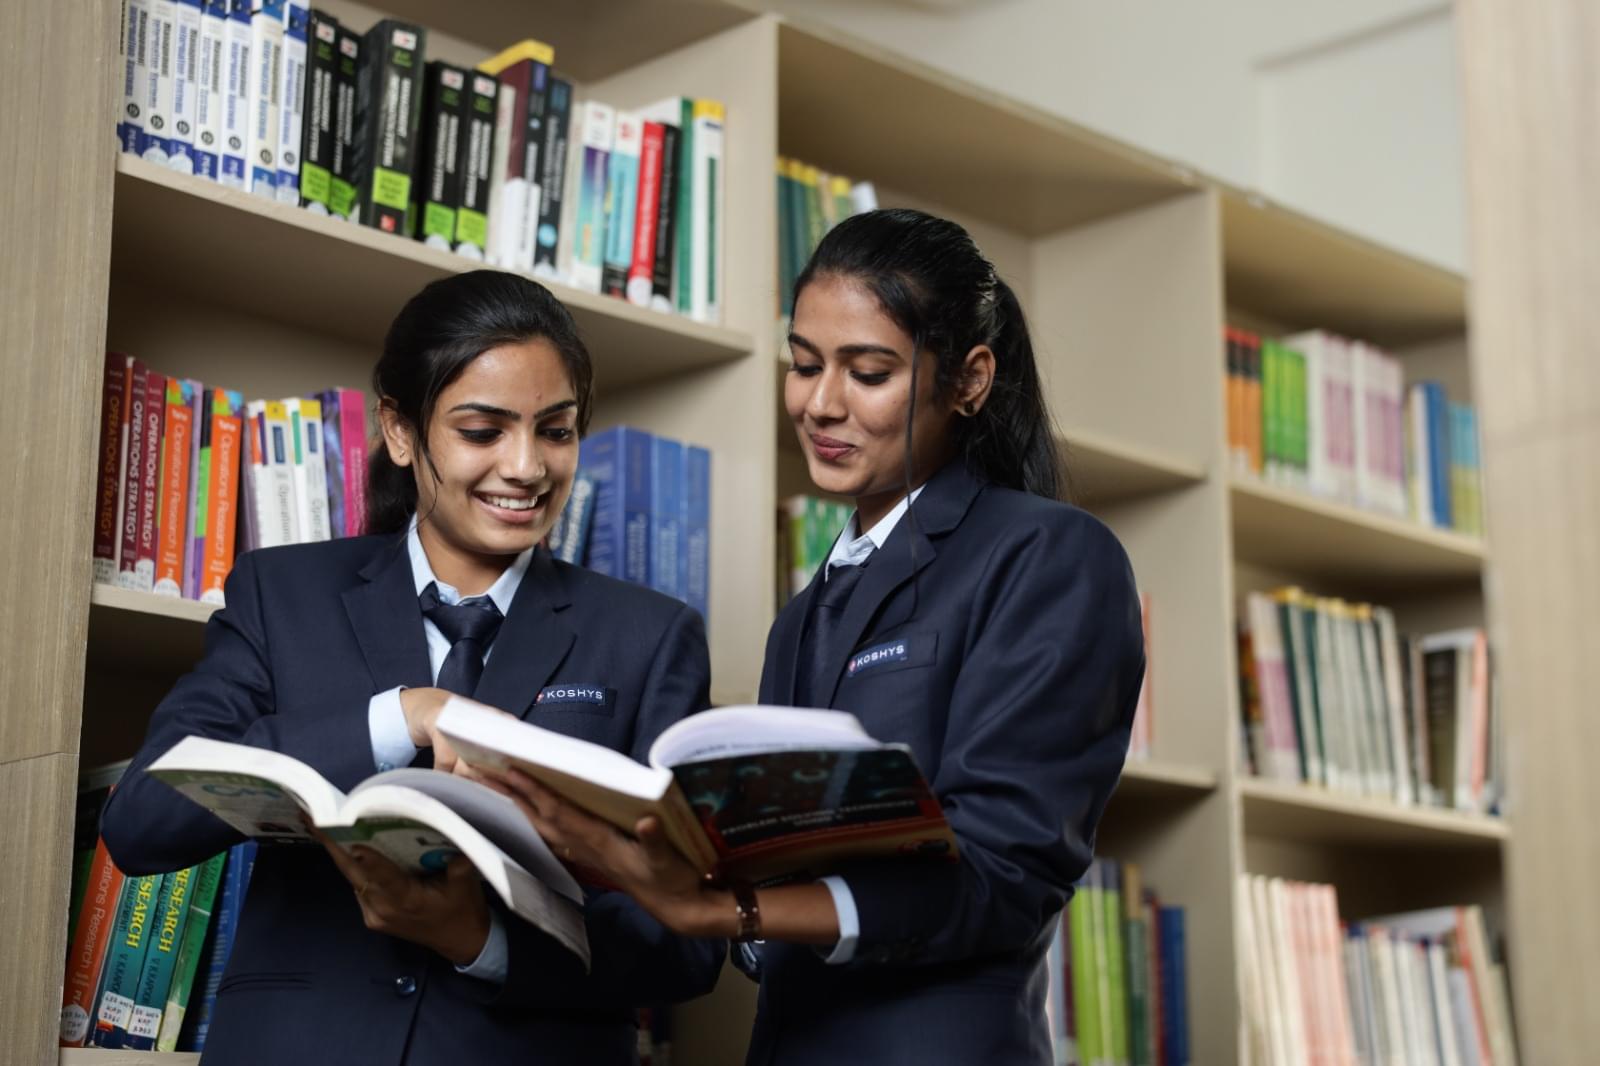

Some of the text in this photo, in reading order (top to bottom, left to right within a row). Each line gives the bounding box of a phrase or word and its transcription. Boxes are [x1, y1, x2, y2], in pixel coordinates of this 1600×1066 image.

[101, 396, 119, 537] OPERATIONS STRATEGY
[126, 401, 143, 542] OPERATIONS STRATEGY
[142, 413, 158, 548] OPERATIONS STRATEGY
[171, 424, 184, 489] Operations
[167, 491, 180, 548] Research
[214, 435, 232, 558] Operations Research
[857, 645, 905, 666] KOSHYS
[546, 688, 603, 700] KOSHYS
[81, 907, 105, 968] Research
[126, 874, 156, 948] ESEARCH
[159, 867, 191, 952] RESEARCH
